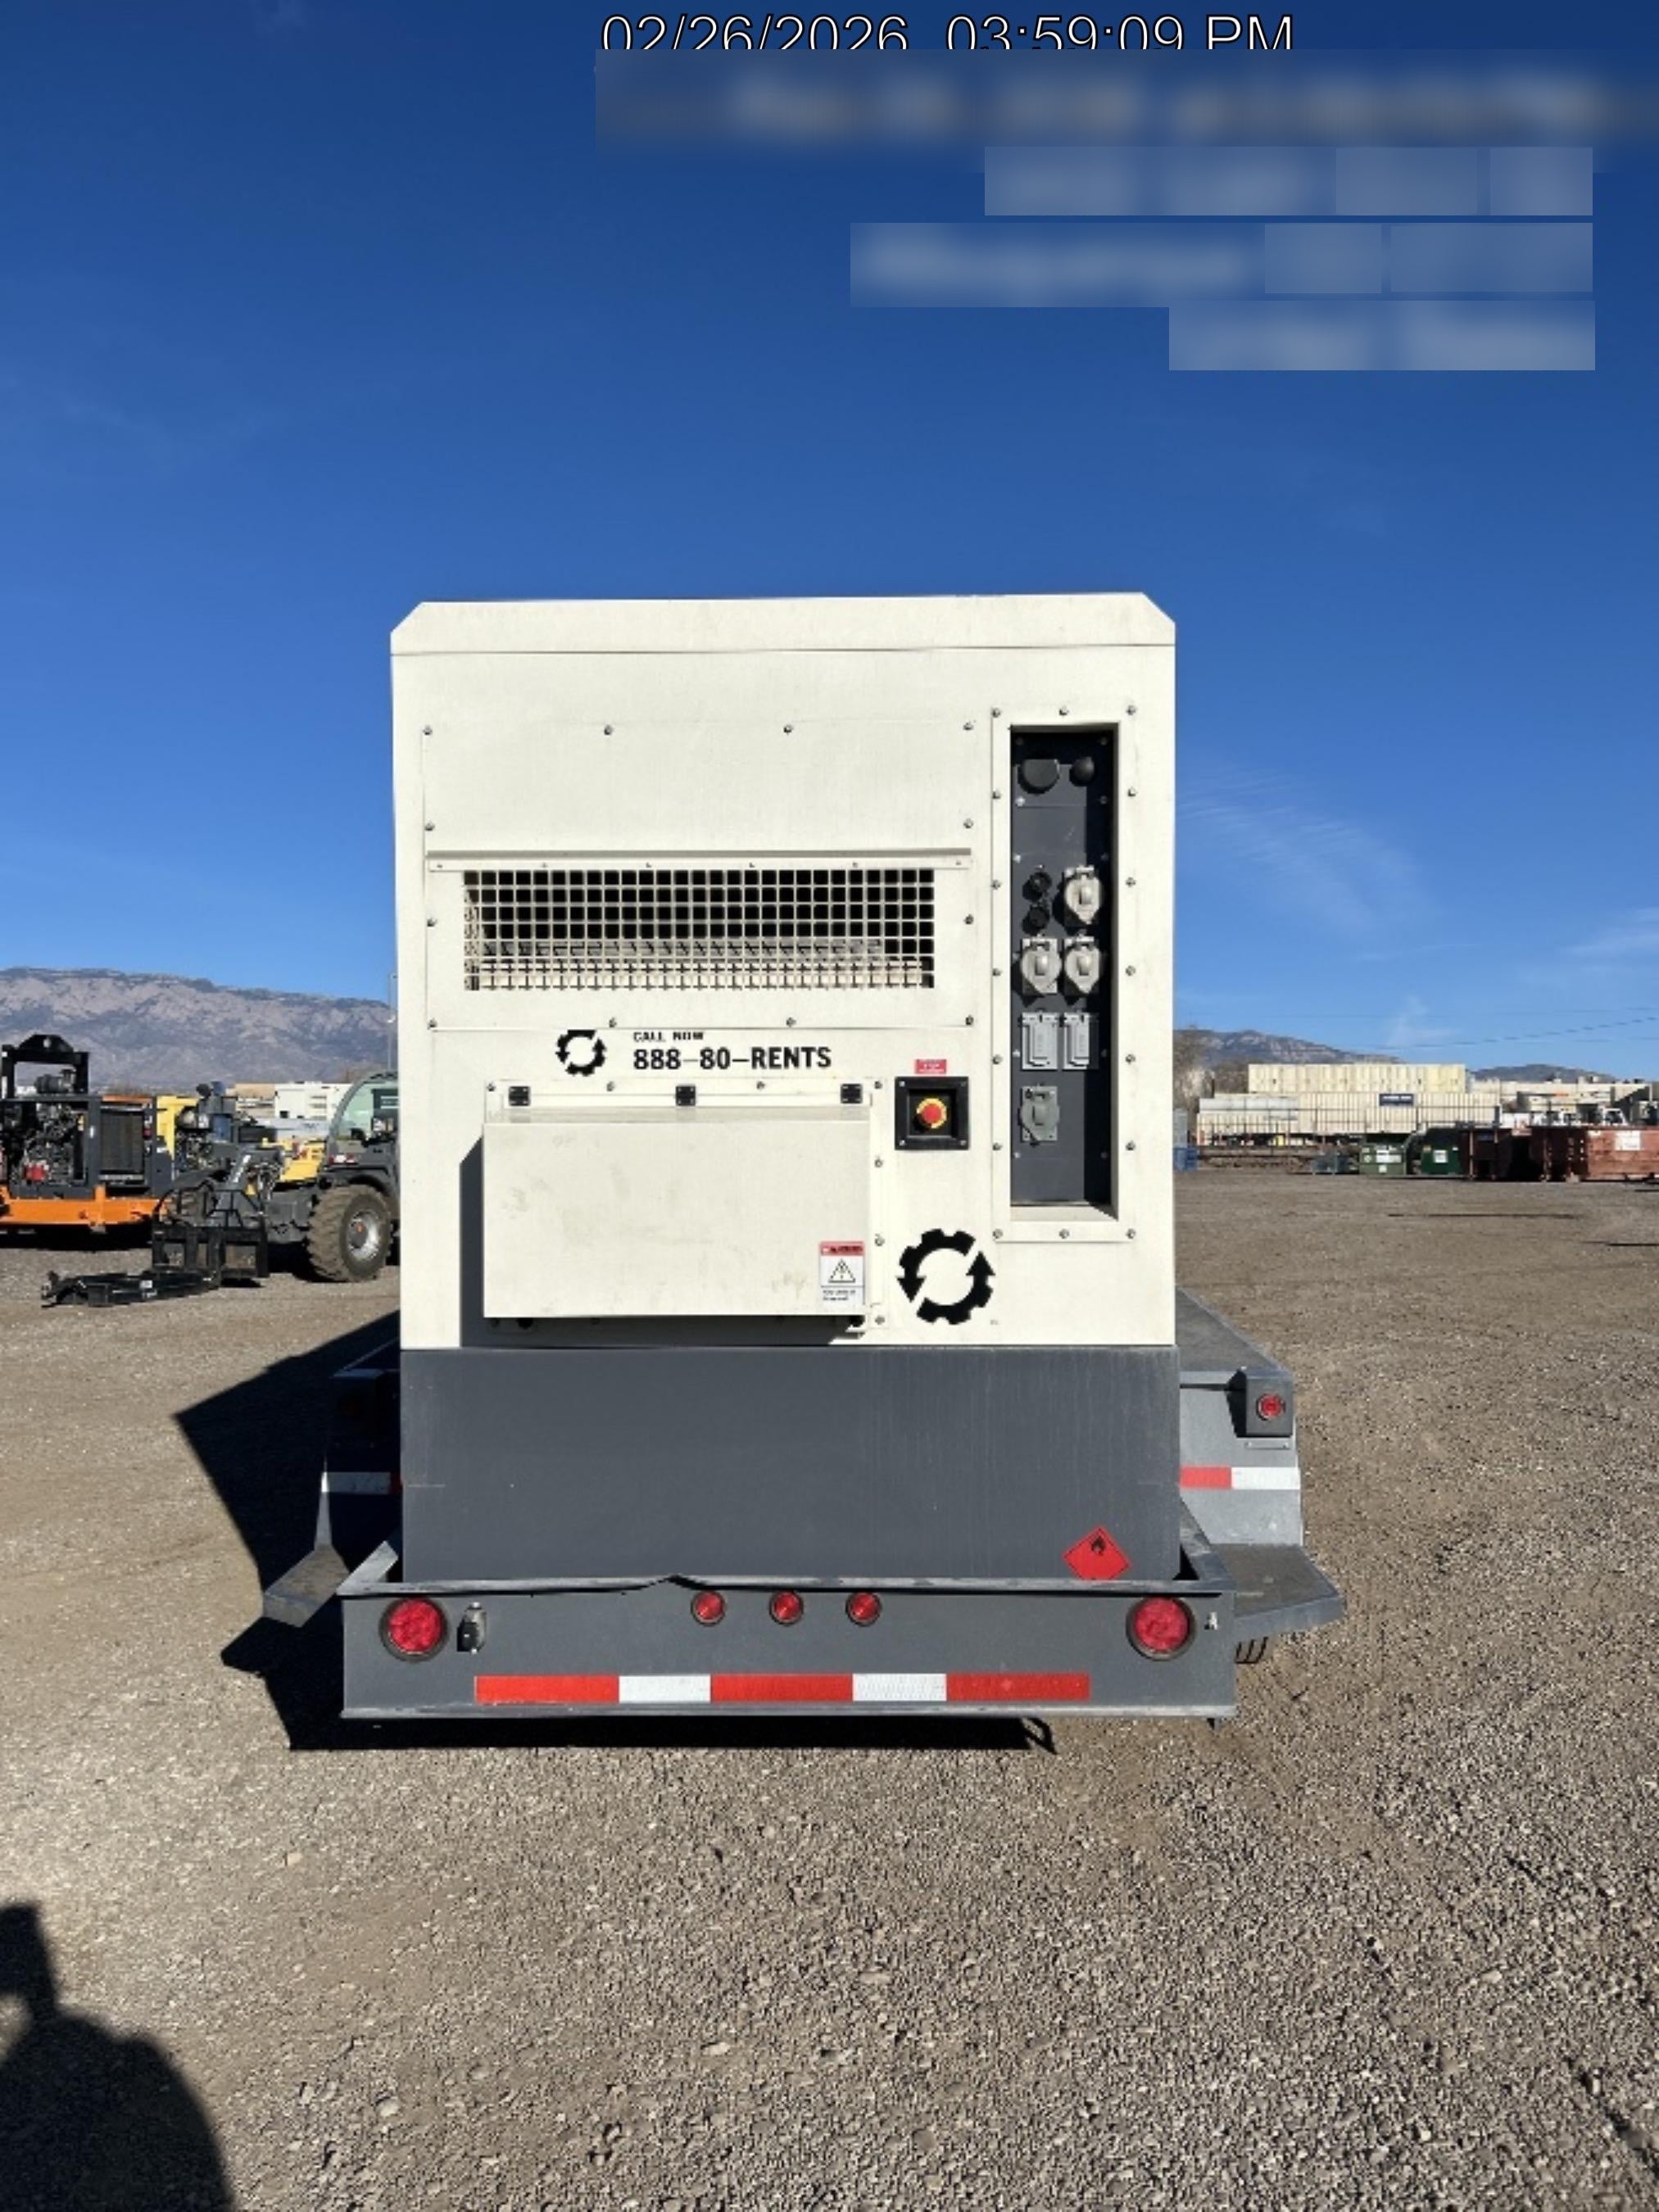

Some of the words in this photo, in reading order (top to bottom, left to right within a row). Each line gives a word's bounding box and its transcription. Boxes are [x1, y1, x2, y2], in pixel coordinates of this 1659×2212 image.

[633, 1031, 665, 1042] CALL
[673, 1031, 704, 1040] NOW
[633, 1047, 832, 1069] 888-80-RENTS
